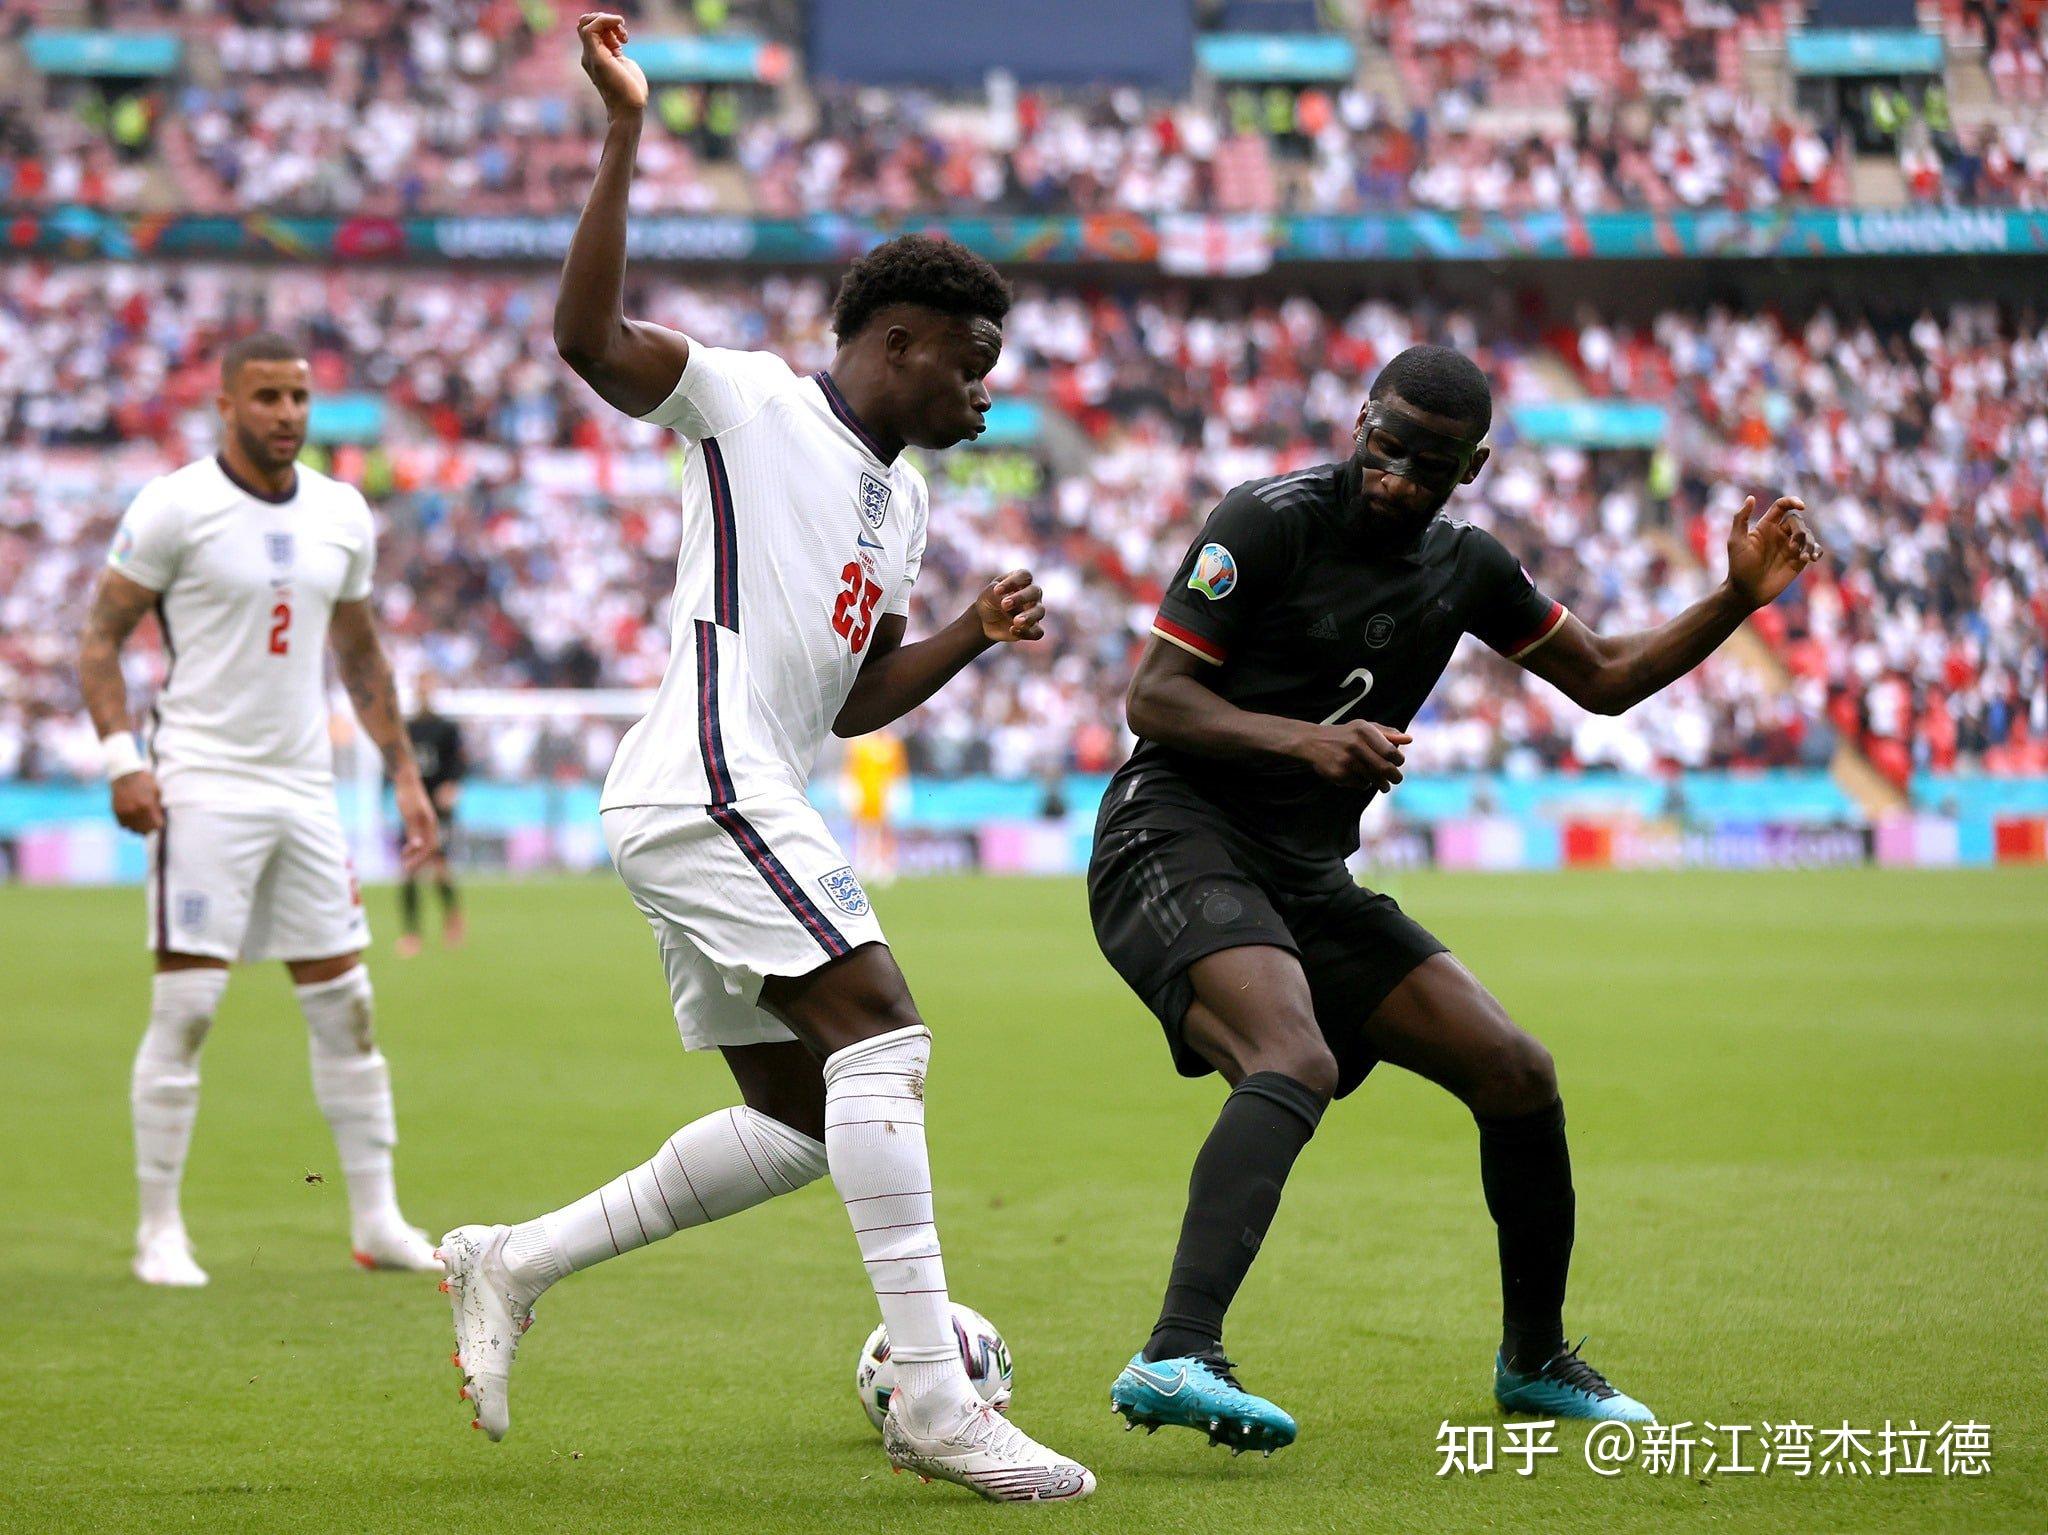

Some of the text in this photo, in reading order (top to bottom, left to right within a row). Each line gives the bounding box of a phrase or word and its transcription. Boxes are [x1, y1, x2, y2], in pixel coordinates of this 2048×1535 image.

[1838, 214, 2006, 252] LONDON
[269, 603, 291, 656] 2
[832, 561, 884, 655] 25
[1319, 667, 1374, 726] 2
